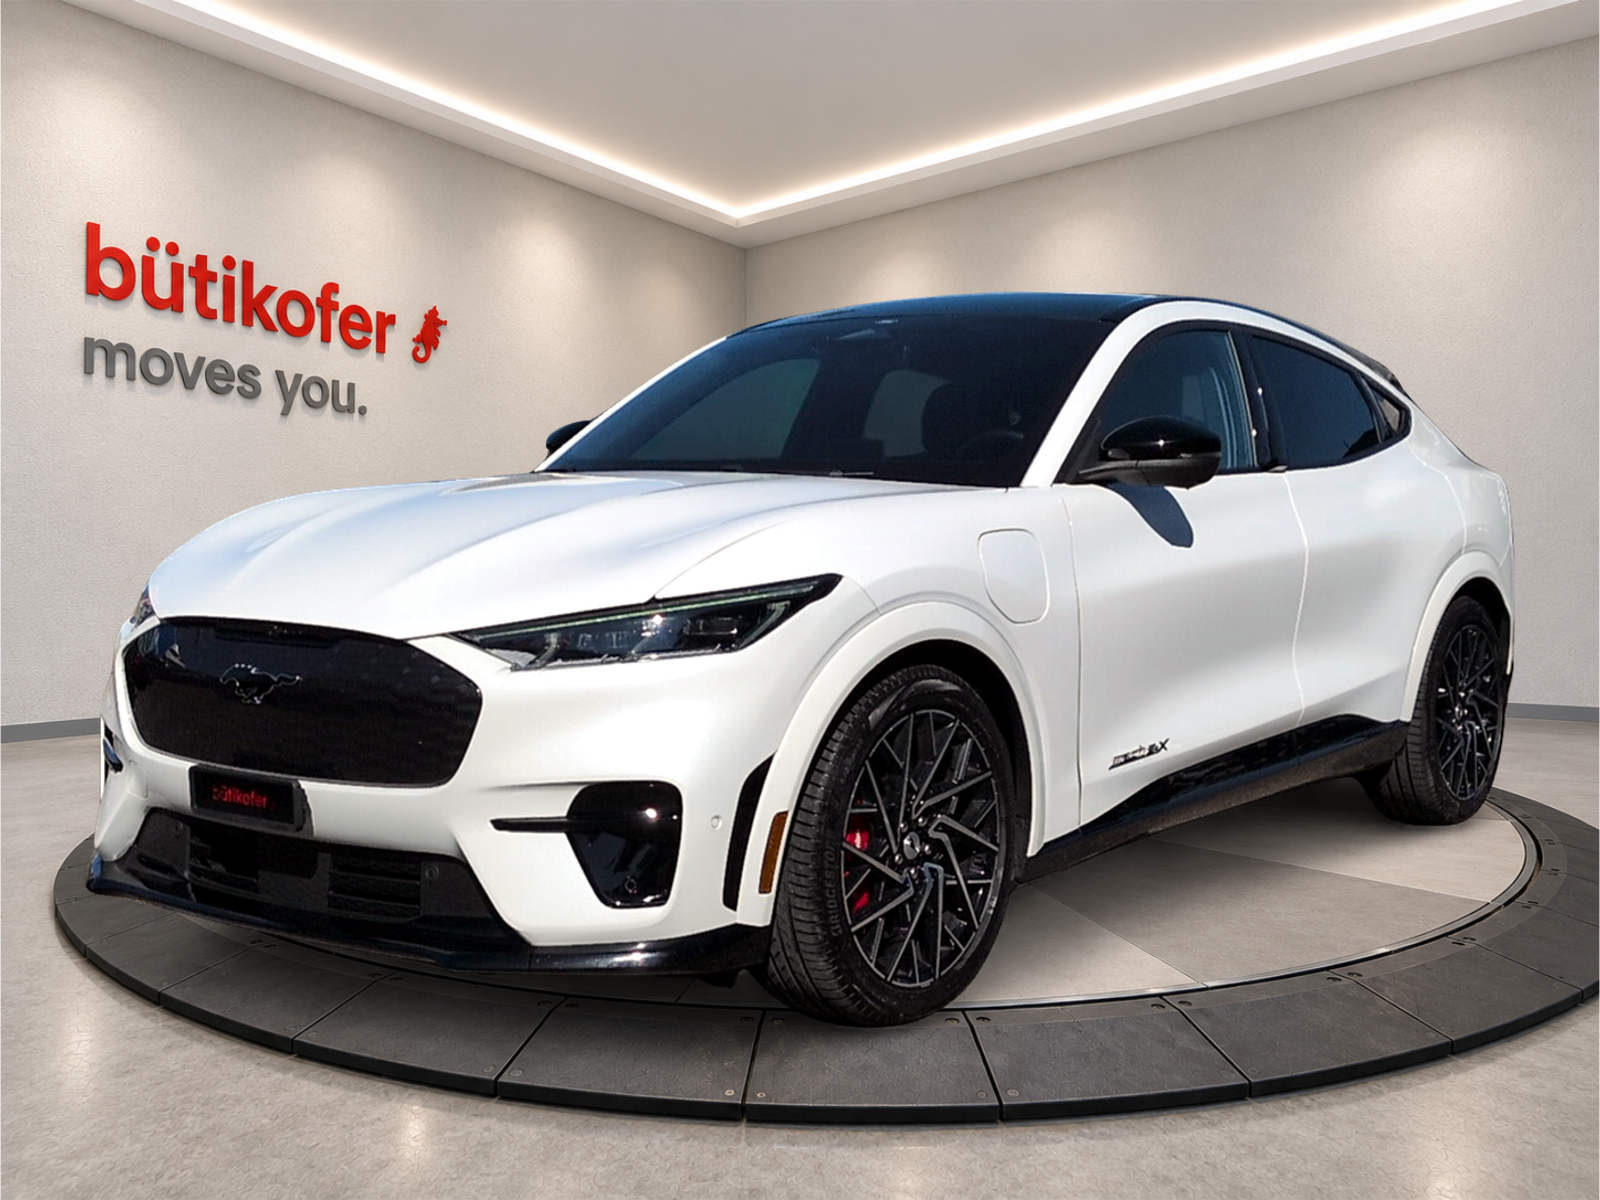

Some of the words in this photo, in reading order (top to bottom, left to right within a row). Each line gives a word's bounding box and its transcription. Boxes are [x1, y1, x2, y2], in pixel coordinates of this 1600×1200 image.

[85, 221, 397, 355] bütikofer
[83, 336, 262, 401] moves
[274, 369, 368, 417] you.
